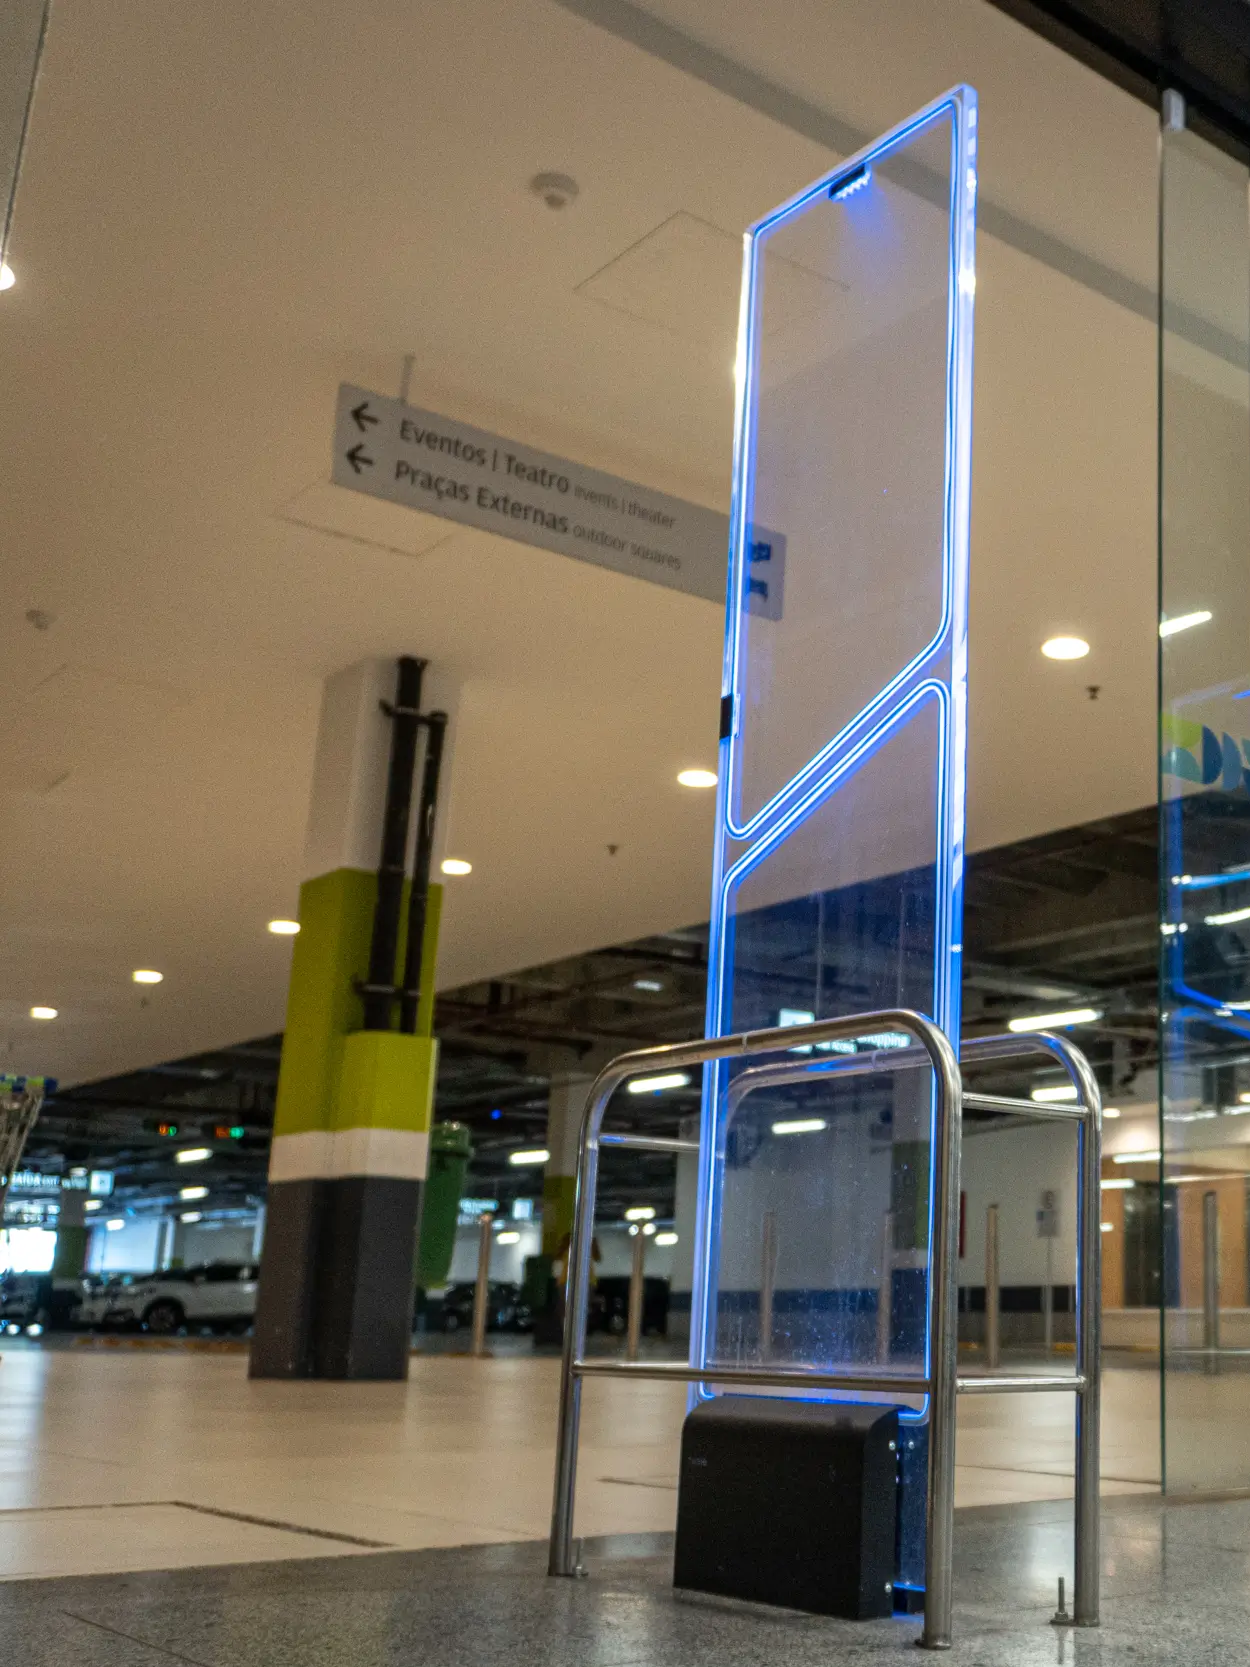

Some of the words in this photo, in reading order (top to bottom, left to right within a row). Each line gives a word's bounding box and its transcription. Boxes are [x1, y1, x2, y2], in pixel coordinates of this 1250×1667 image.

[394, 459, 470, 503] Praças
[476, 486, 569, 533] Externas
[573, 525, 627, 552] outdoor
[400, 418, 487, 466] Eventos
[505, 453, 570, 494] Teatro
[627, 501, 676, 529] theater
